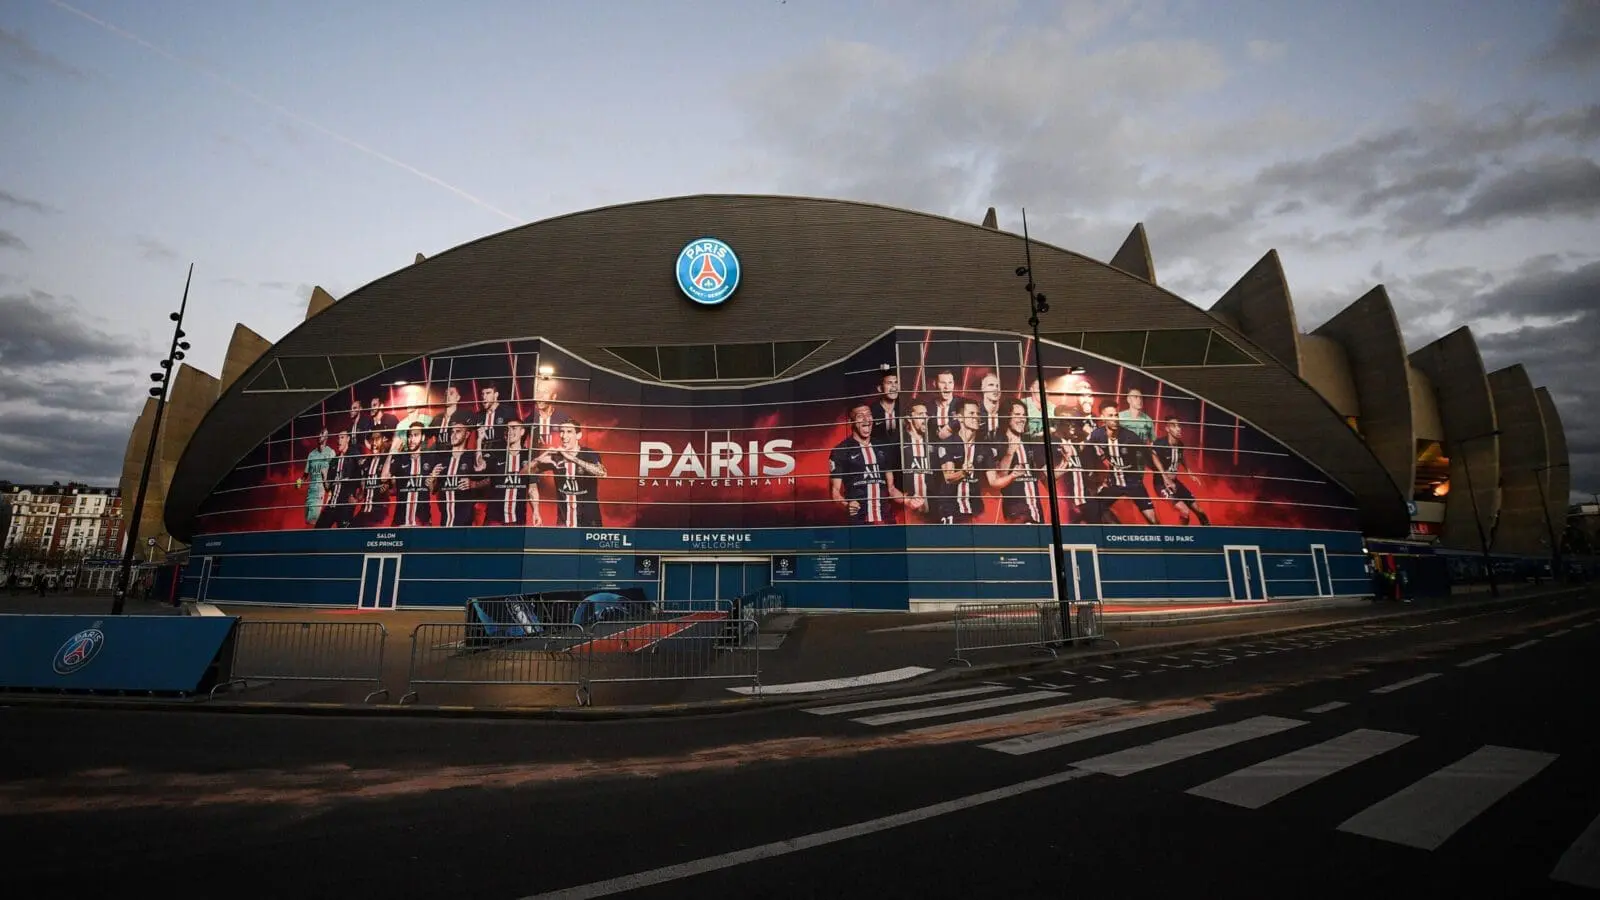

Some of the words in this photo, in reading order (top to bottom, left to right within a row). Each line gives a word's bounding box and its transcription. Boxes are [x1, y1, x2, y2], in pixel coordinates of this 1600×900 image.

[686, 243, 727, 259] PARIS
[639, 439, 796, 478] PARIS
[639, 477, 795, 487] SAINT-GERMAIN
[585, 532, 620, 541] PORTE
[622, 534, 632, 547] L
[682, 533, 752, 542] BIENVENUE
[1106, 534, 1161, 542] CONCIERGERIE
[599, 541, 620, 549] GATE
[692, 541, 741, 549] WELCOME
[74, 631, 102, 642] PARIS
